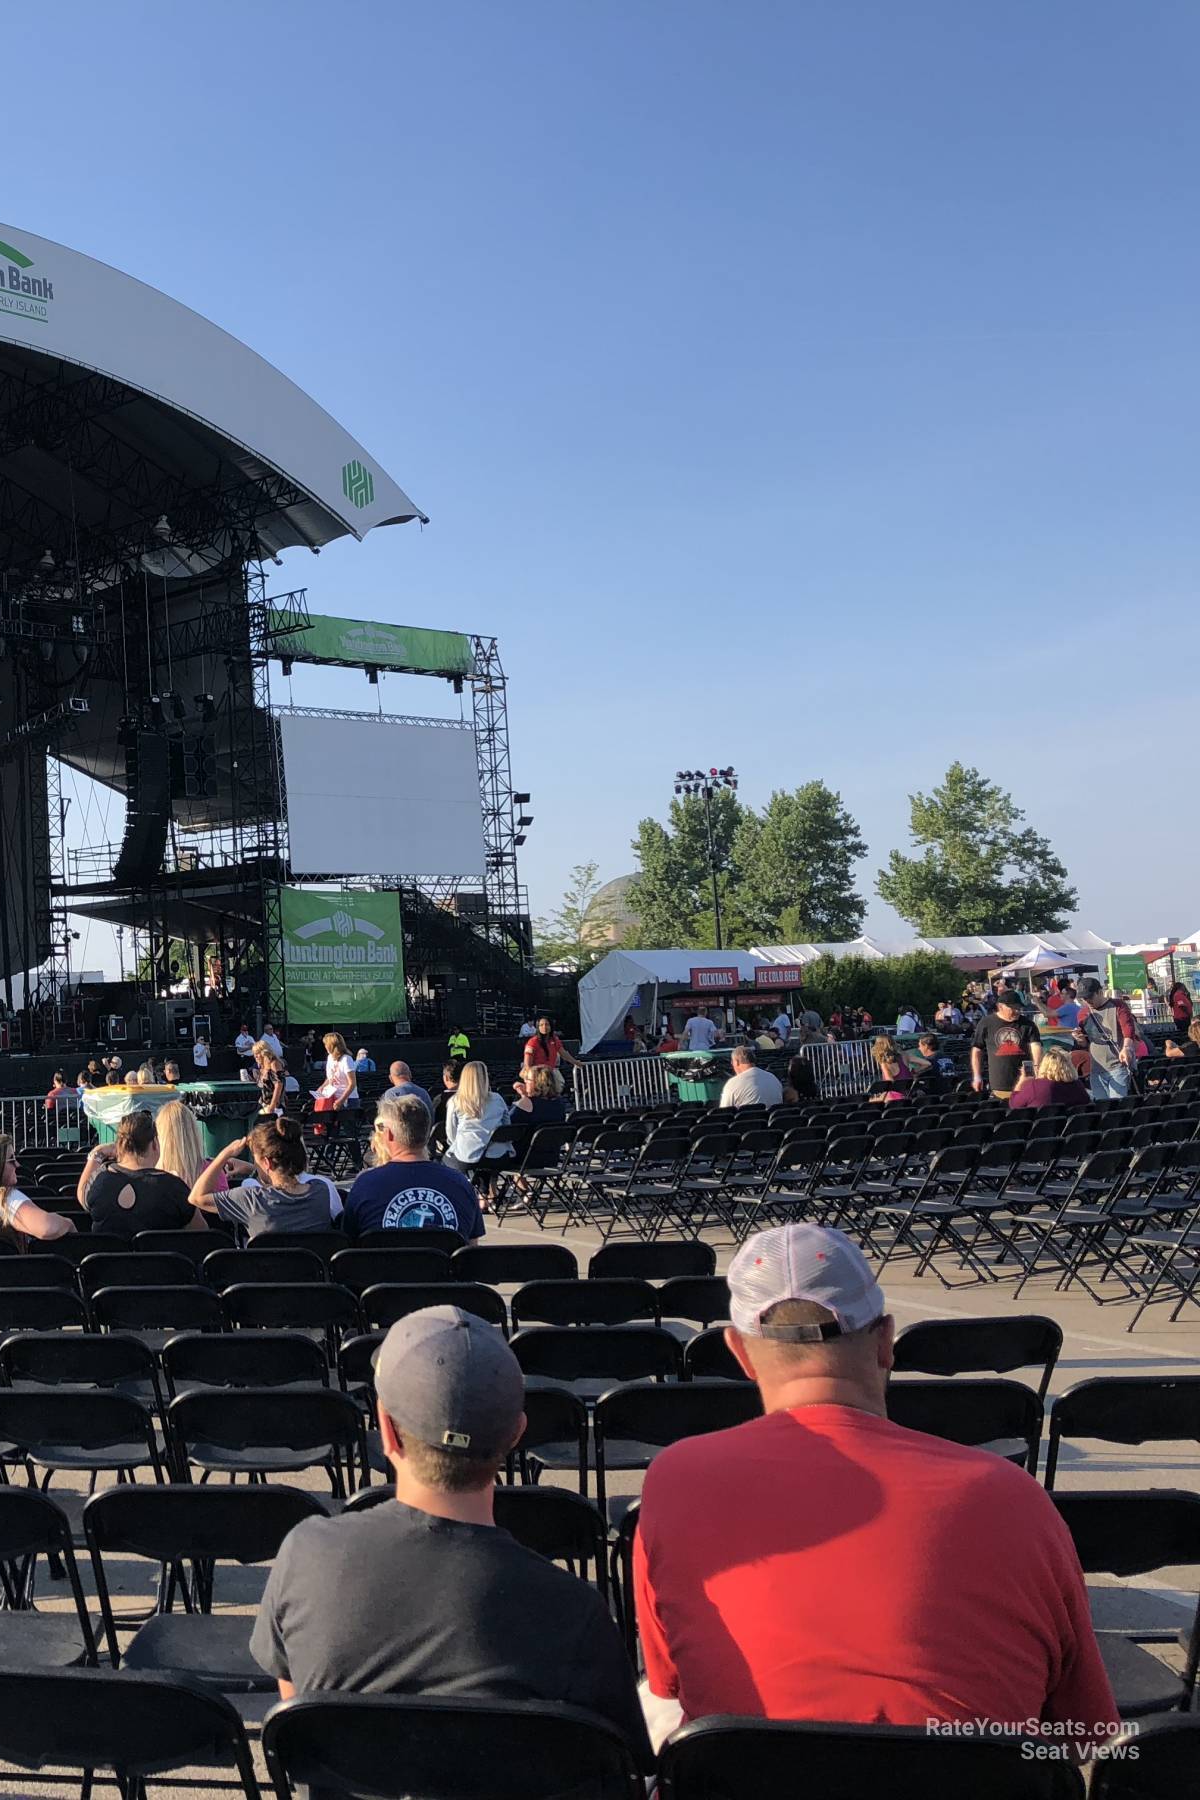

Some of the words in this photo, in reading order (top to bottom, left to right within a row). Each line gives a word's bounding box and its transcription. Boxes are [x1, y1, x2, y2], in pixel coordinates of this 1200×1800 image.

[8, 265, 54, 300] Bank
[16, 300, 47, 316] ISLAND
[368, 940, 398, 963] Bank
[286, 971, 321, 982] PAVILION
[698, 972, 733, 986] COCKTAILS
[758, 971, 768, 983] ICE
[769, 971, 784, 982] COLD
[785, 970, 799, 982] BEER
[385, 1190, 416, 1228] PEACE
[417, 1190, 455, 1220] FROGS
